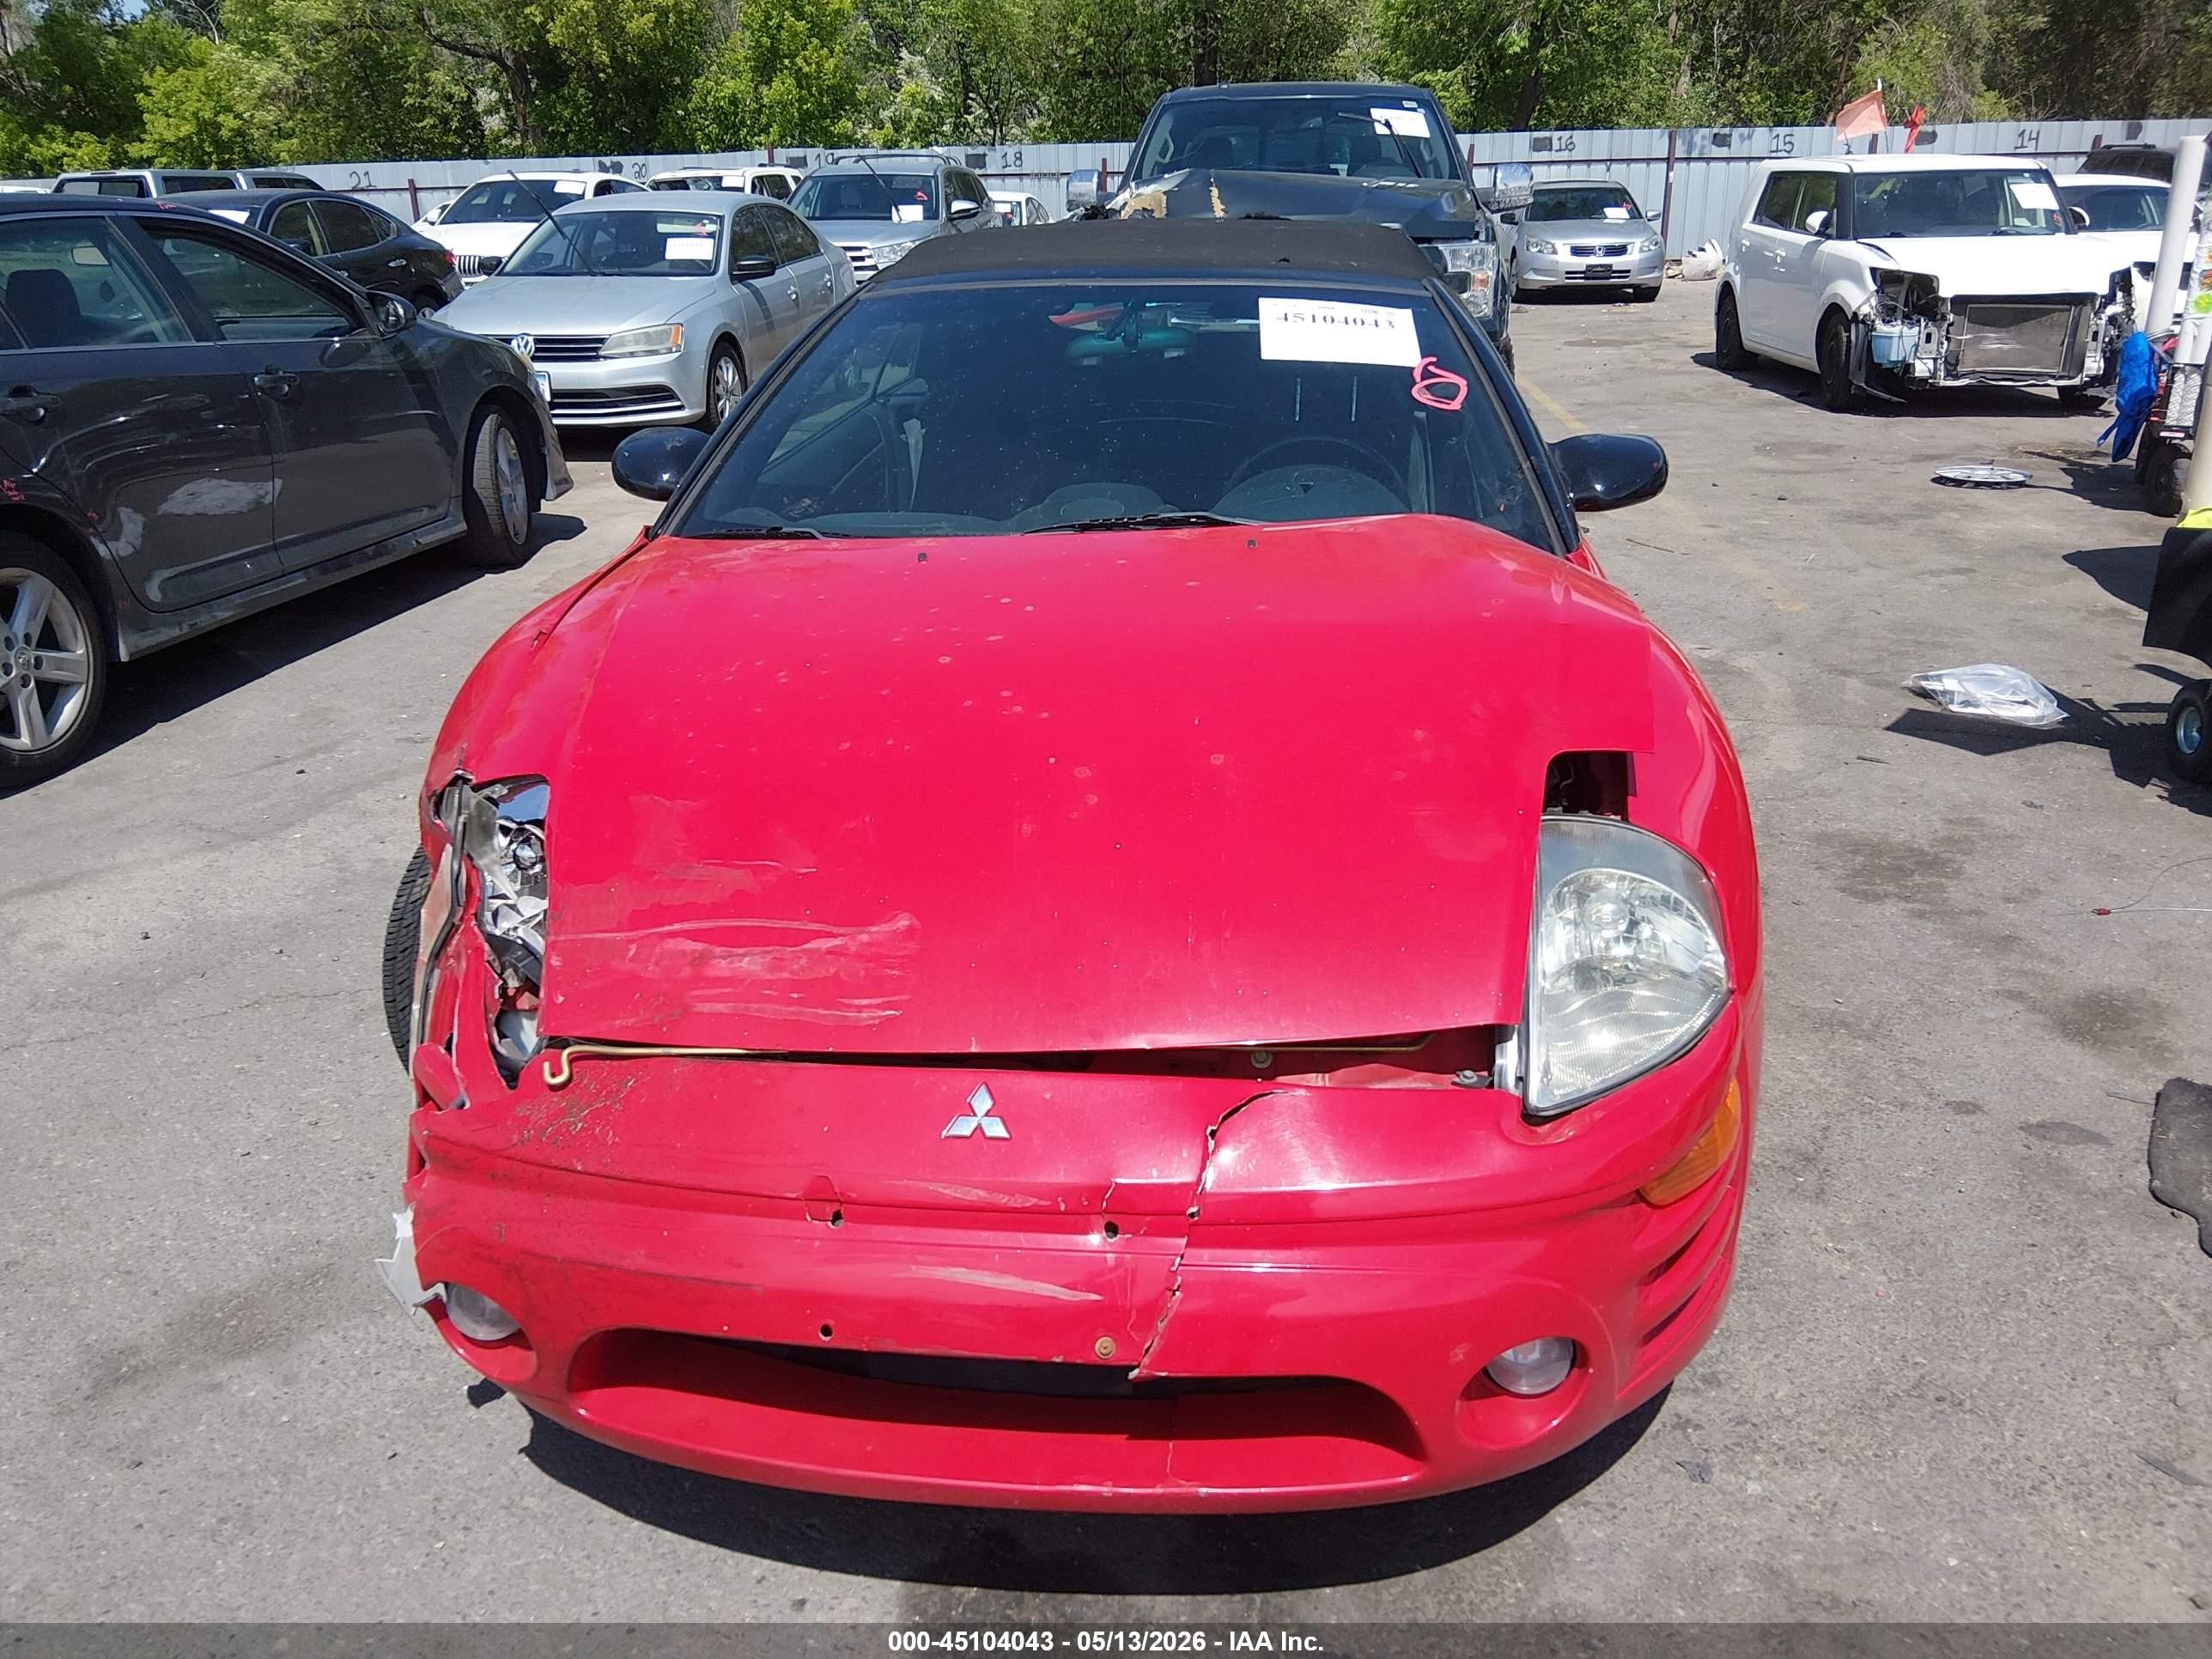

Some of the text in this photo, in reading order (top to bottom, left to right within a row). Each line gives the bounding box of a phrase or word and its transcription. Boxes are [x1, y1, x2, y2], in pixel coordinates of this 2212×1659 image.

[1554, 135, 1576, 153] 16
[1769, 133, 1795, 154] 15
[2014, 129, 2040, 150] 14
[1001, 150, 1024, 169] 18
[349, 171, 377, 191] 21
